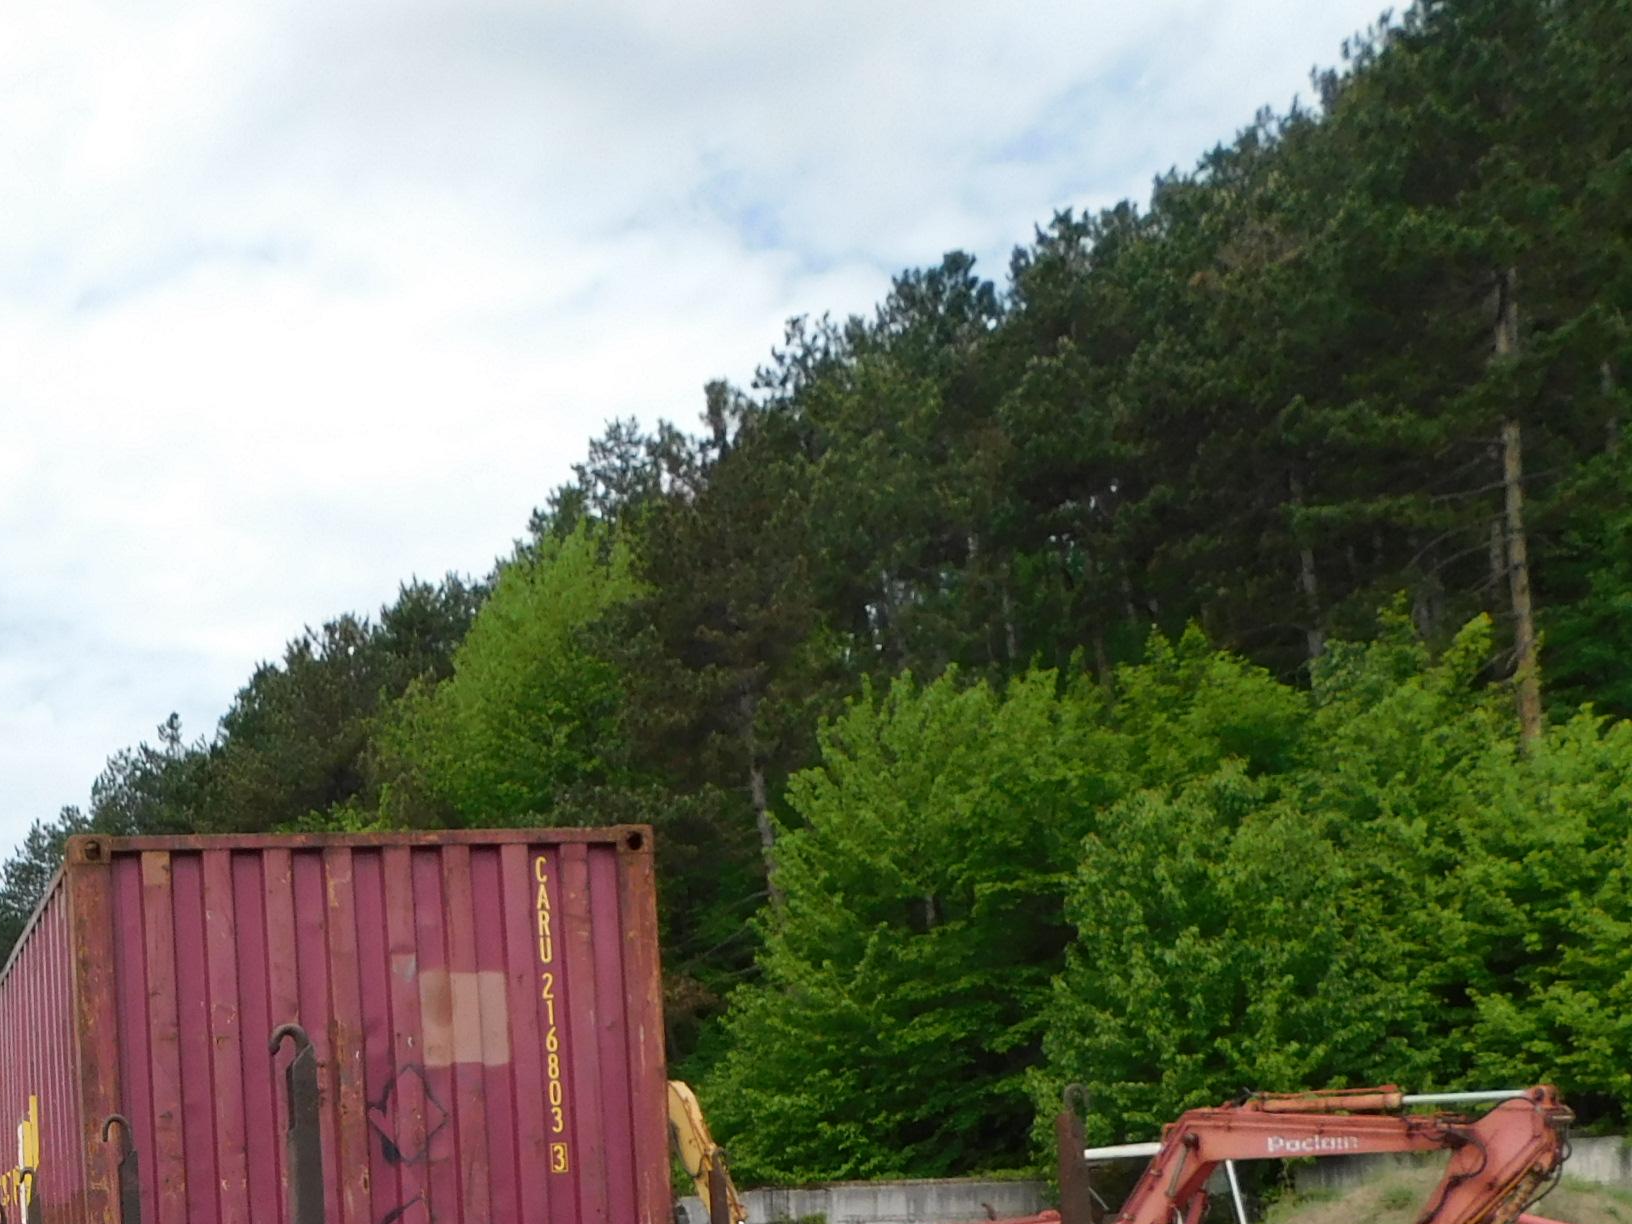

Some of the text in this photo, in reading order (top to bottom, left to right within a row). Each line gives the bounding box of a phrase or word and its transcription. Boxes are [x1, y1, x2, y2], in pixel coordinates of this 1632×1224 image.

[535, 855, 566, 1171] CARU 216803 3
